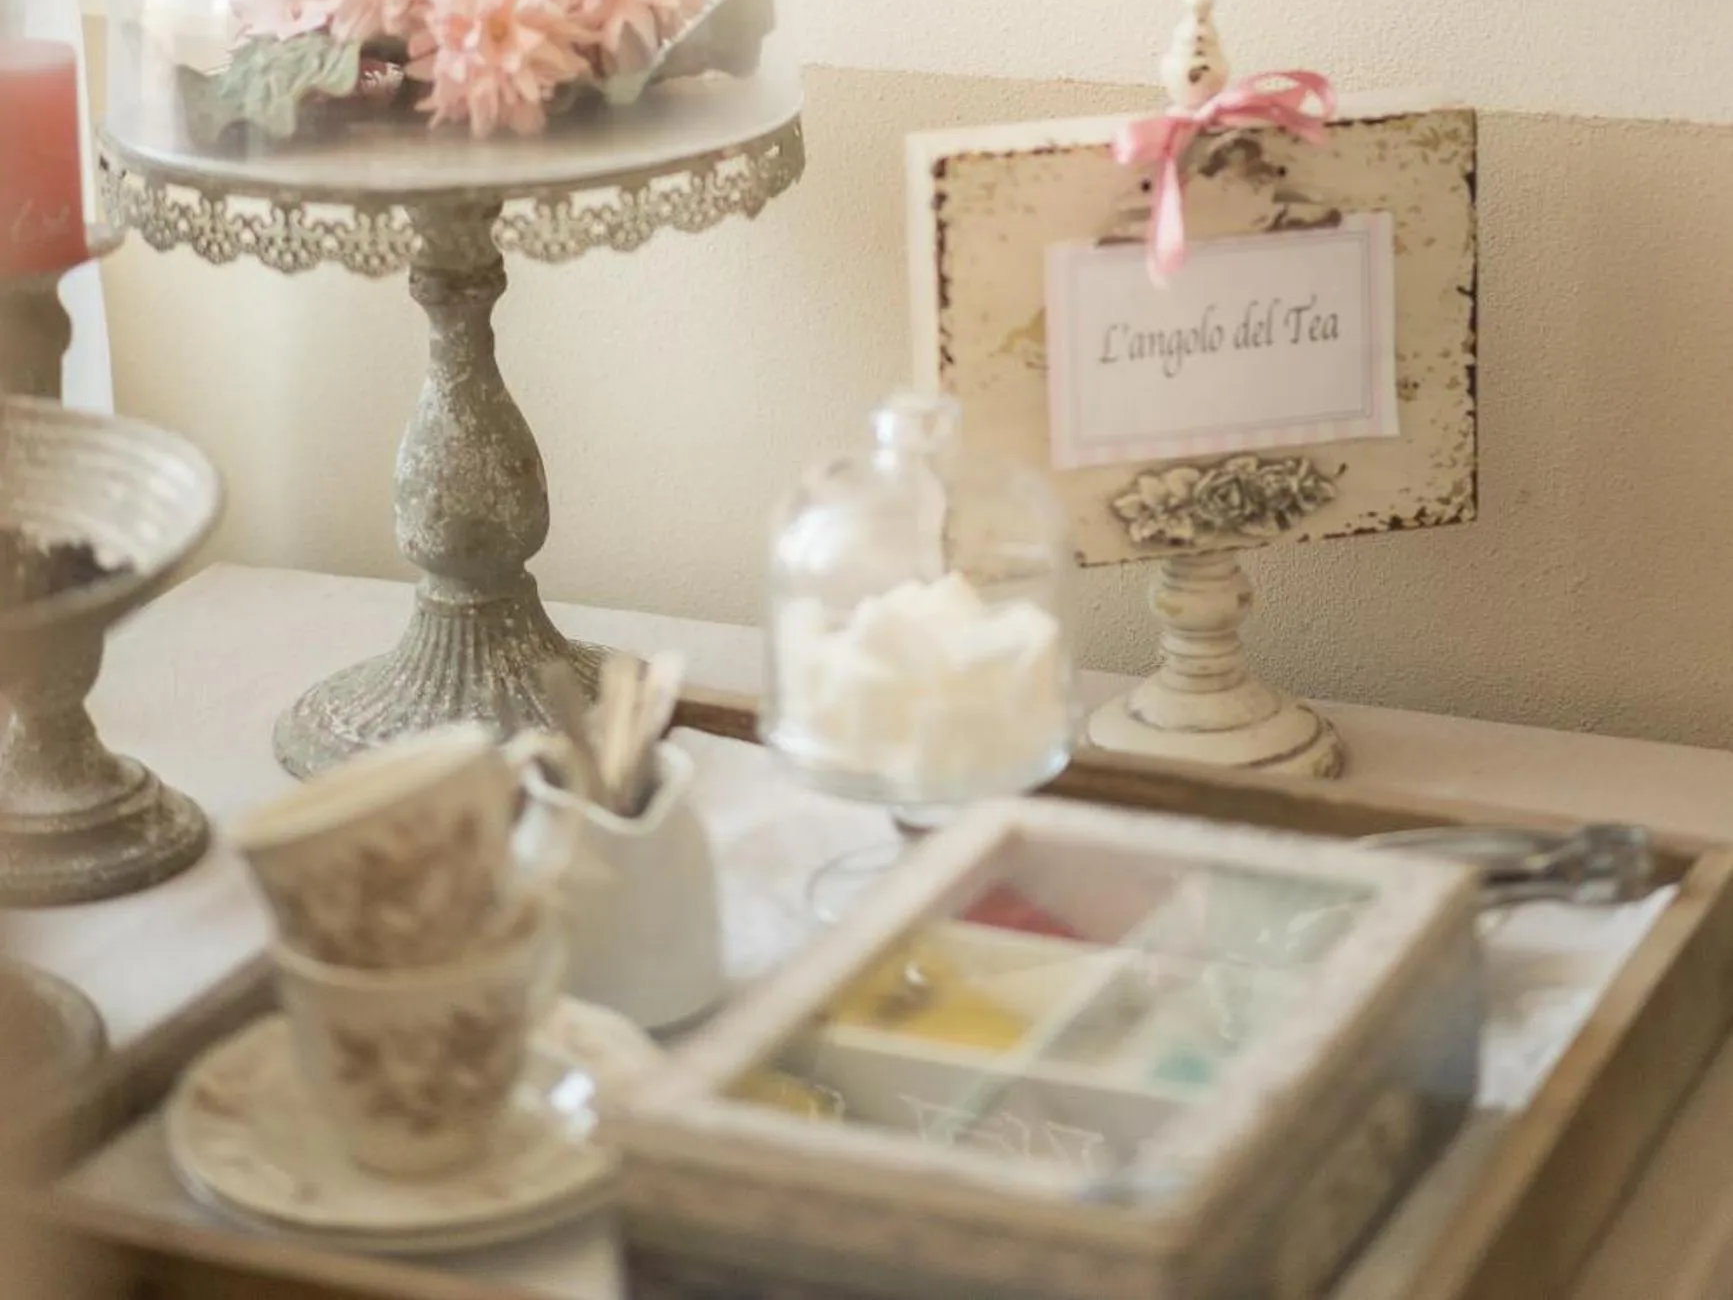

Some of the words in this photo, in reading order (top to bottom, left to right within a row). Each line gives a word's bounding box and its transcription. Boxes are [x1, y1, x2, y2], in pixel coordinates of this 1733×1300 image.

[1098, 303, 1226, 379] L'angolo
[1232, 297, 1282, 351] del
[1284, 294, 1340, 346] Tea
